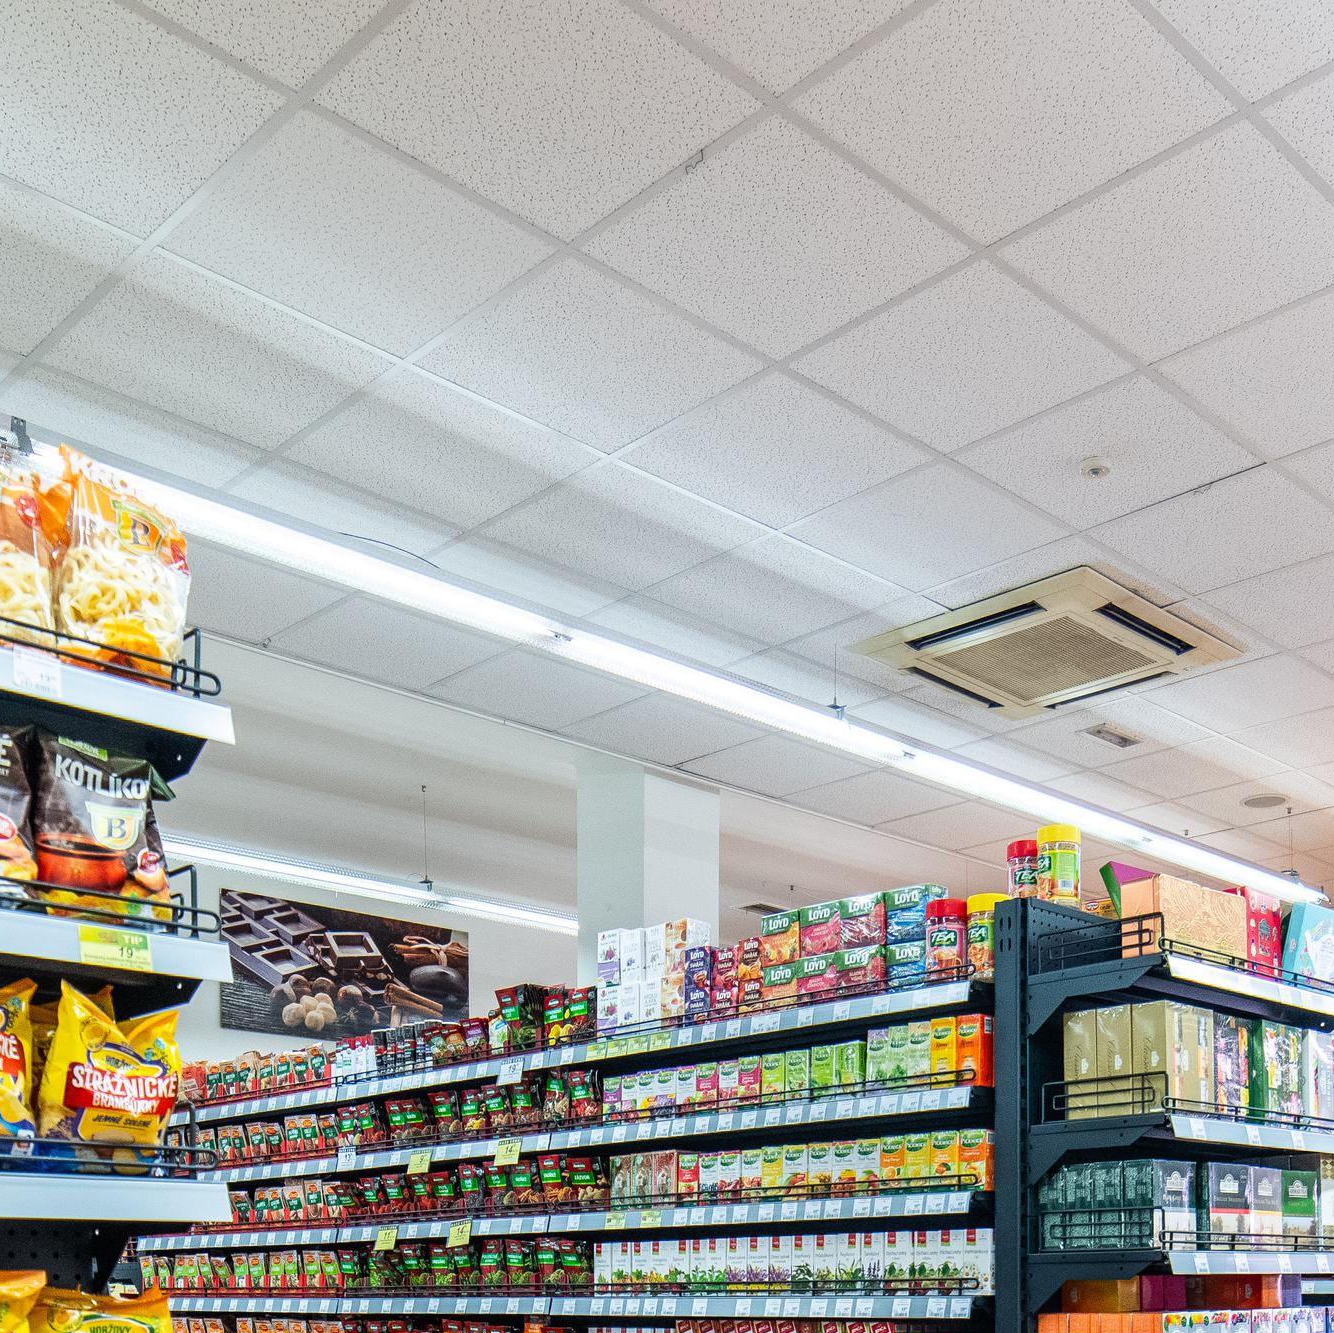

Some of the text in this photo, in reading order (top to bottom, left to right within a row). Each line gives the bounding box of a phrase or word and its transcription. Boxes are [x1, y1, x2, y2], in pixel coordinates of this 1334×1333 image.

[106, 817, 126, 840] B
[895, 891, 917, 905] LOYD
[808, 908, 830, 920] LOYD
[769, 918, 788, 930] LOYD
[931, 931, 955, 942] TEA
[804, 958, 826, 971] LOYD
[771, 968, 791, 981] LOYD
